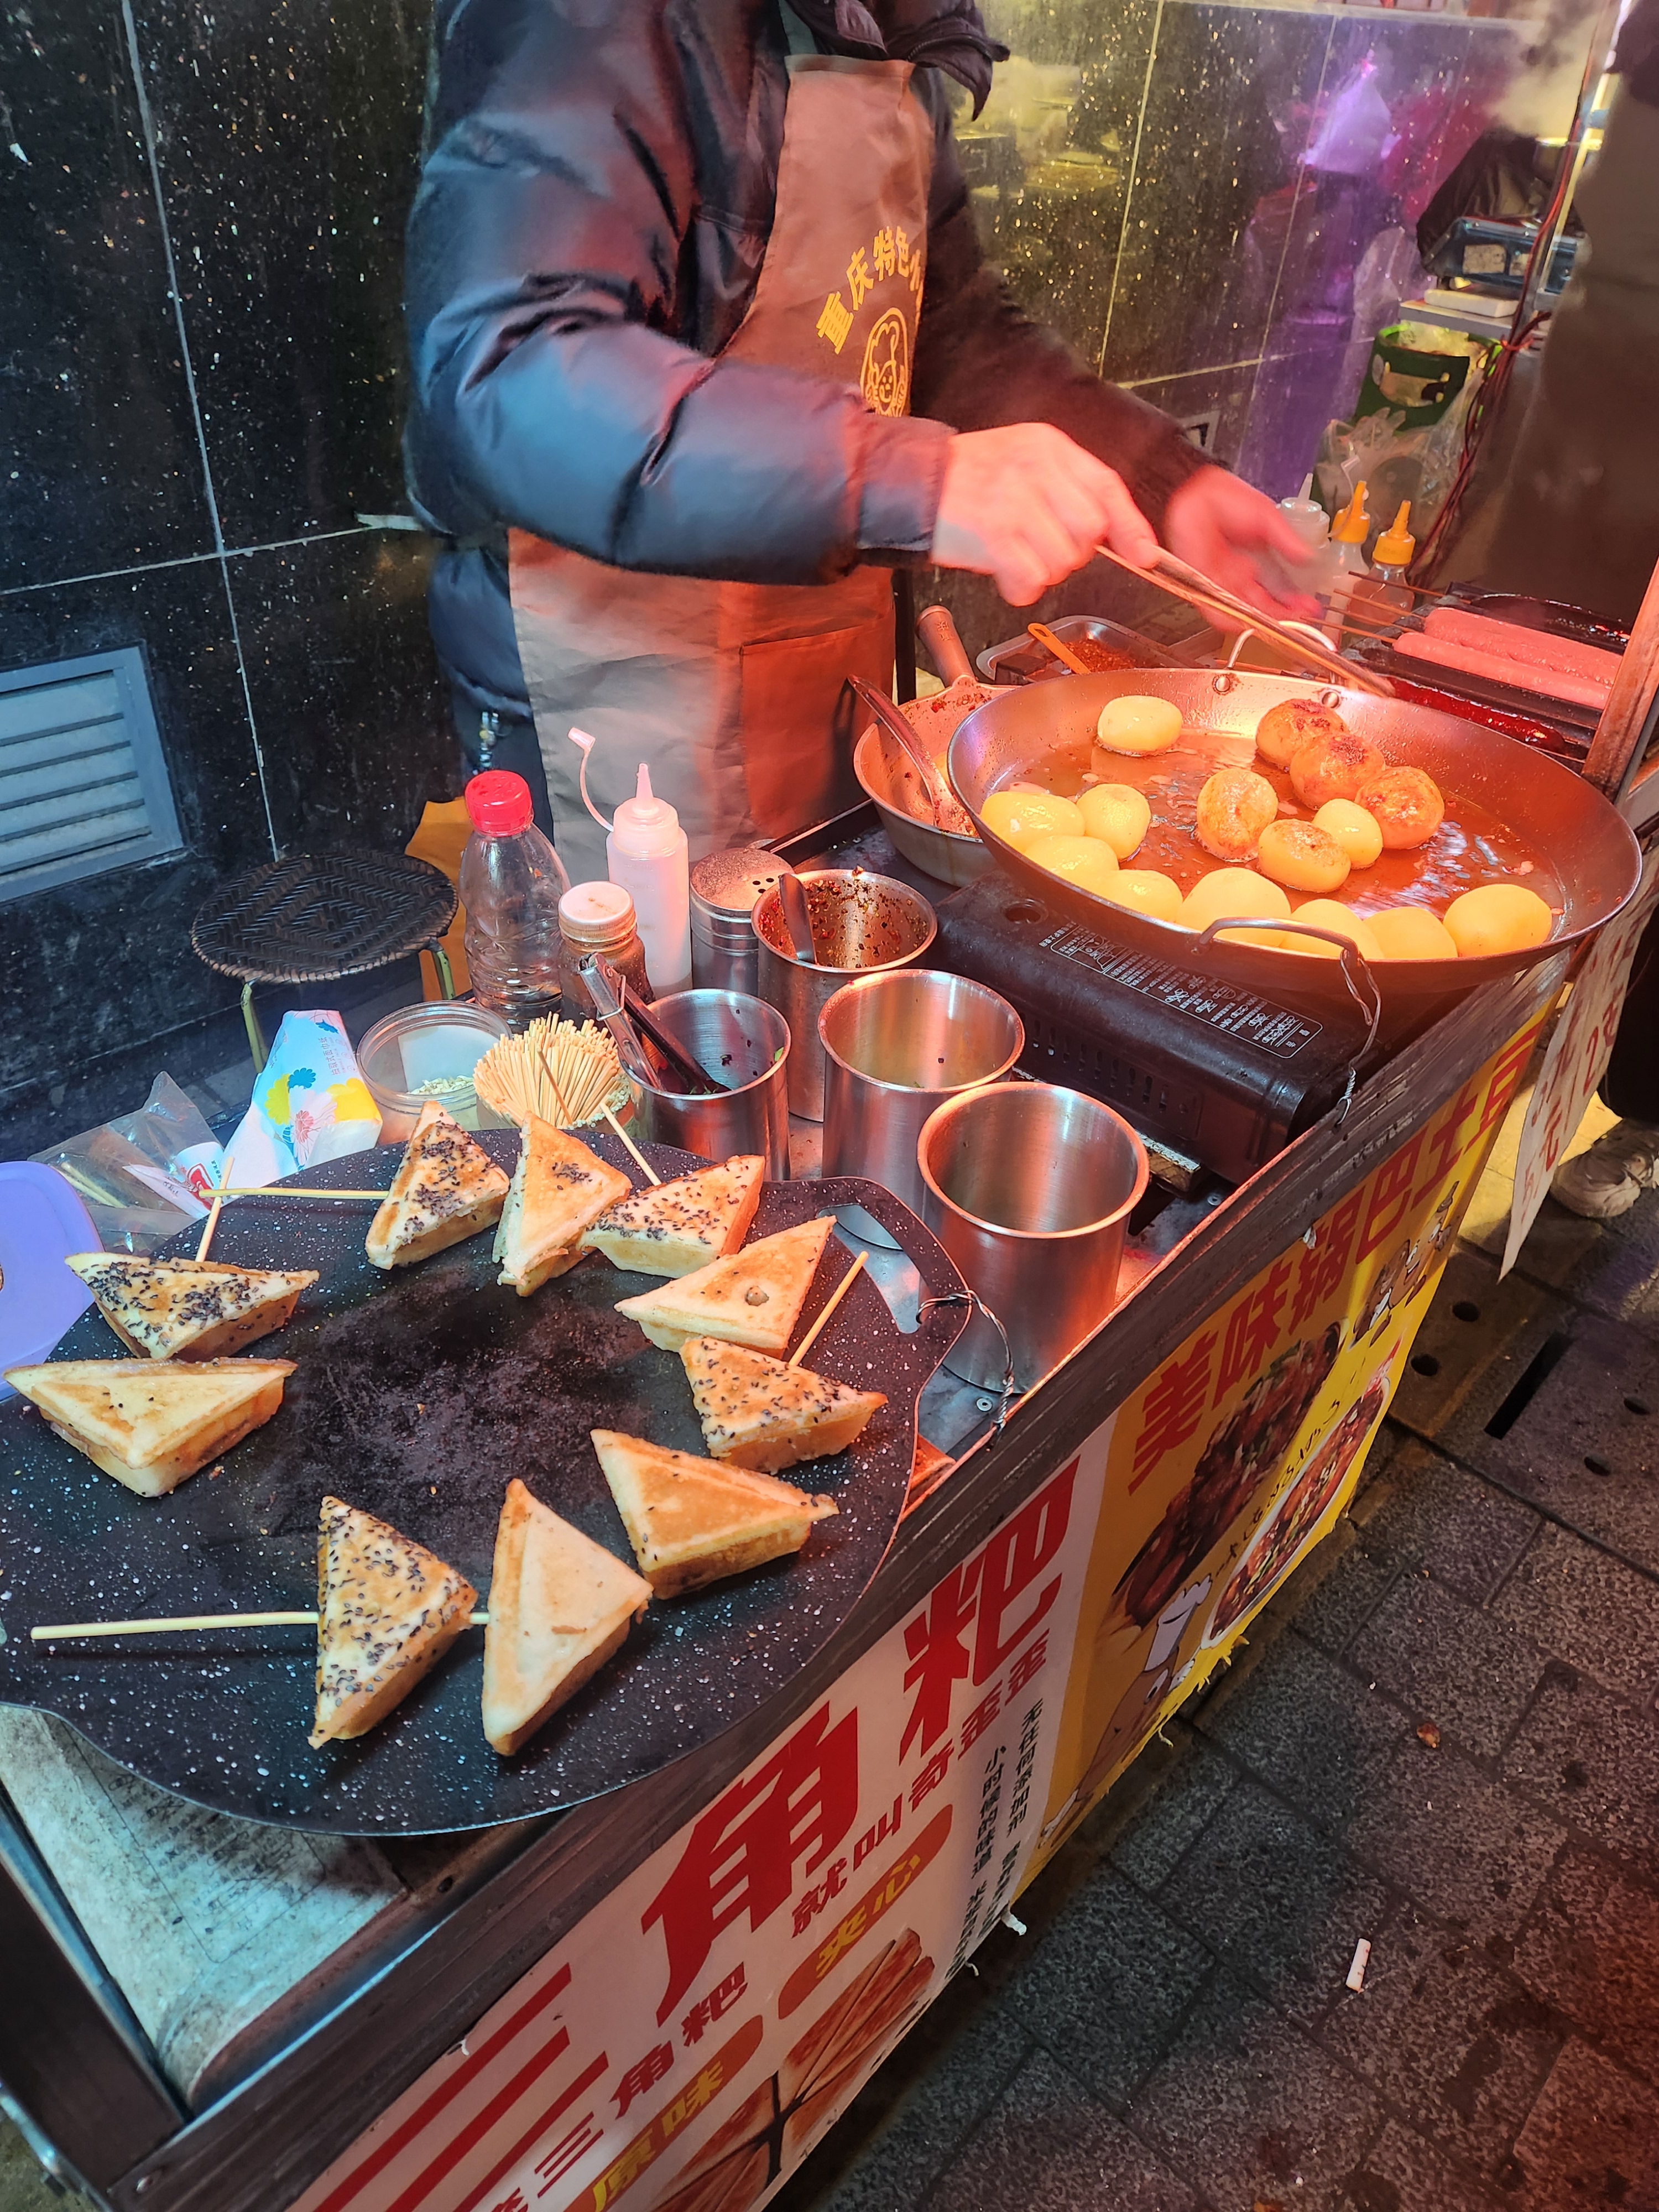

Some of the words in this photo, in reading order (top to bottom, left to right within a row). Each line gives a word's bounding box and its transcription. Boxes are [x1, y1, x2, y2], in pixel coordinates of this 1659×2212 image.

[791, 1628, 1050, 1939] 就叫奇歪歪
[815, 1854, 921, 1979] 夹心
